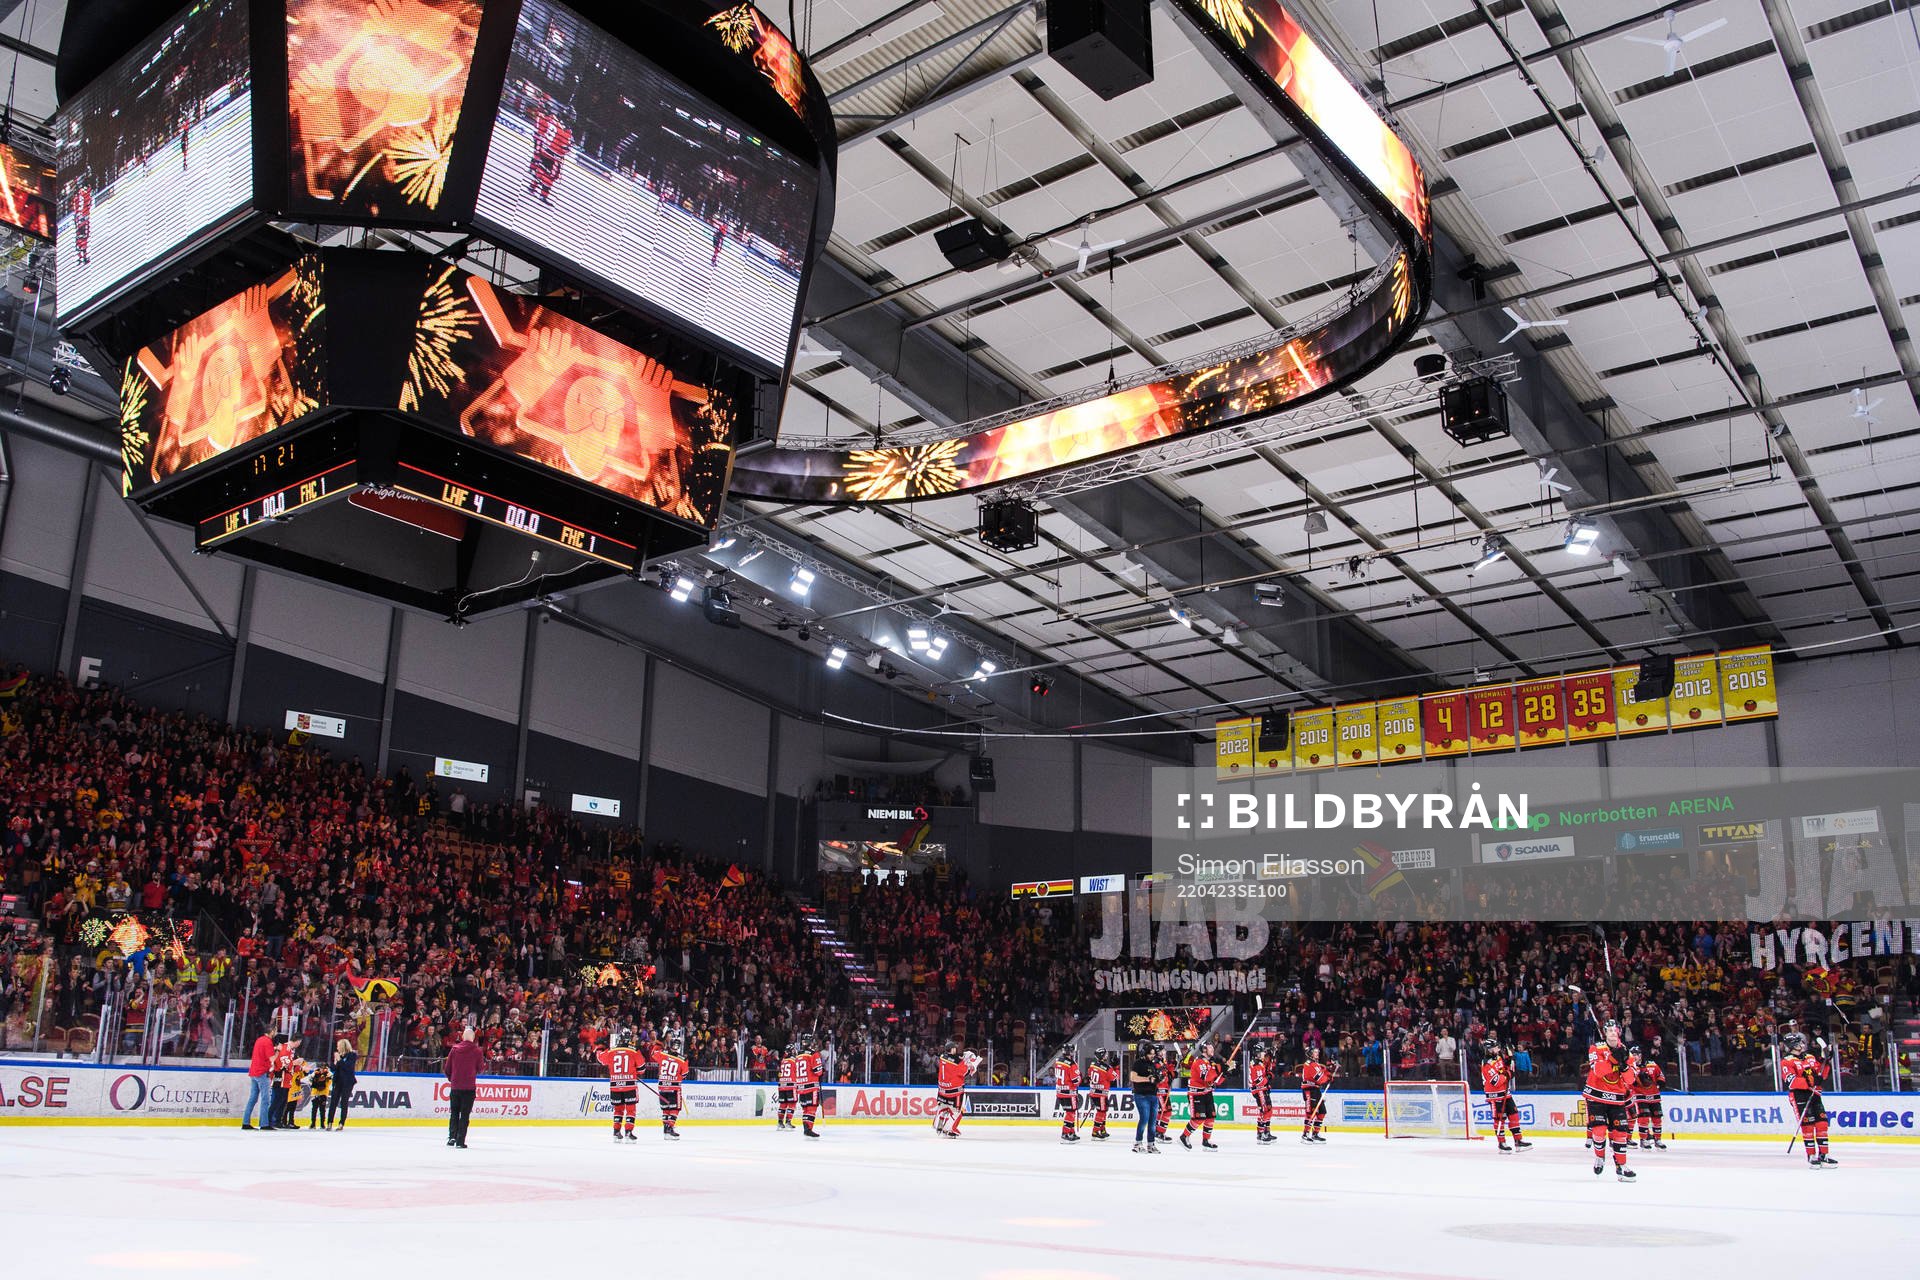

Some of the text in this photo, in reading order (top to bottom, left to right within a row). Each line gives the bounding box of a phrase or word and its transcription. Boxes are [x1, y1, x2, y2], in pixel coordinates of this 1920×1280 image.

[225, 511, 240, 533] LHF
[242, 507, 249, 525] 4
[300, 480, 317, 504] FHC
[321, 477, 326, 496] 1
[441, 483, 469, 507] LHF
[473, 494, 484, 513] 4
[505, 505, 540, 535] 00.0
[560, 525, 585, 549] FHC
[588, 536, 596, 553] 1
[1674, 678, 1712, 699] 2012
[1728, 669, 1768, 692] 2015
[1524, 694, 1556, 724] 28
[1573, 687, 1606, 717] 35
[1437, 706, 1453, 733] 4
[1479, 701, 1504, 729] 12
[1341, 723, 1371, 741] 2018
[1384, 717, 1415, 736] 2016
[1219, 738, 1249, 755] 2022
[1300, 728, 1328, 746] 2019
[868, 809, 914, 820] NIEMI BIL
[1559, 804, 1658, 828] Norrbotten
[1667, 795, 1735, 817] ARENA
[1702, 823, 1764, 839] TITAN
[1515, 843, 1560, 856] SCANIA
[1089, 878, 1109, 891] WIST
[1090, 879, 1270, 962] JIAB
[613, 1055, 629, 1073] 21
[661, 1060, 679, 1076] 20
[0, 1076, 70, 1108] .SE
[347, 1090, 412, 1109] ANIA
[973, 1103, 1037, 1114] HYDROCK
